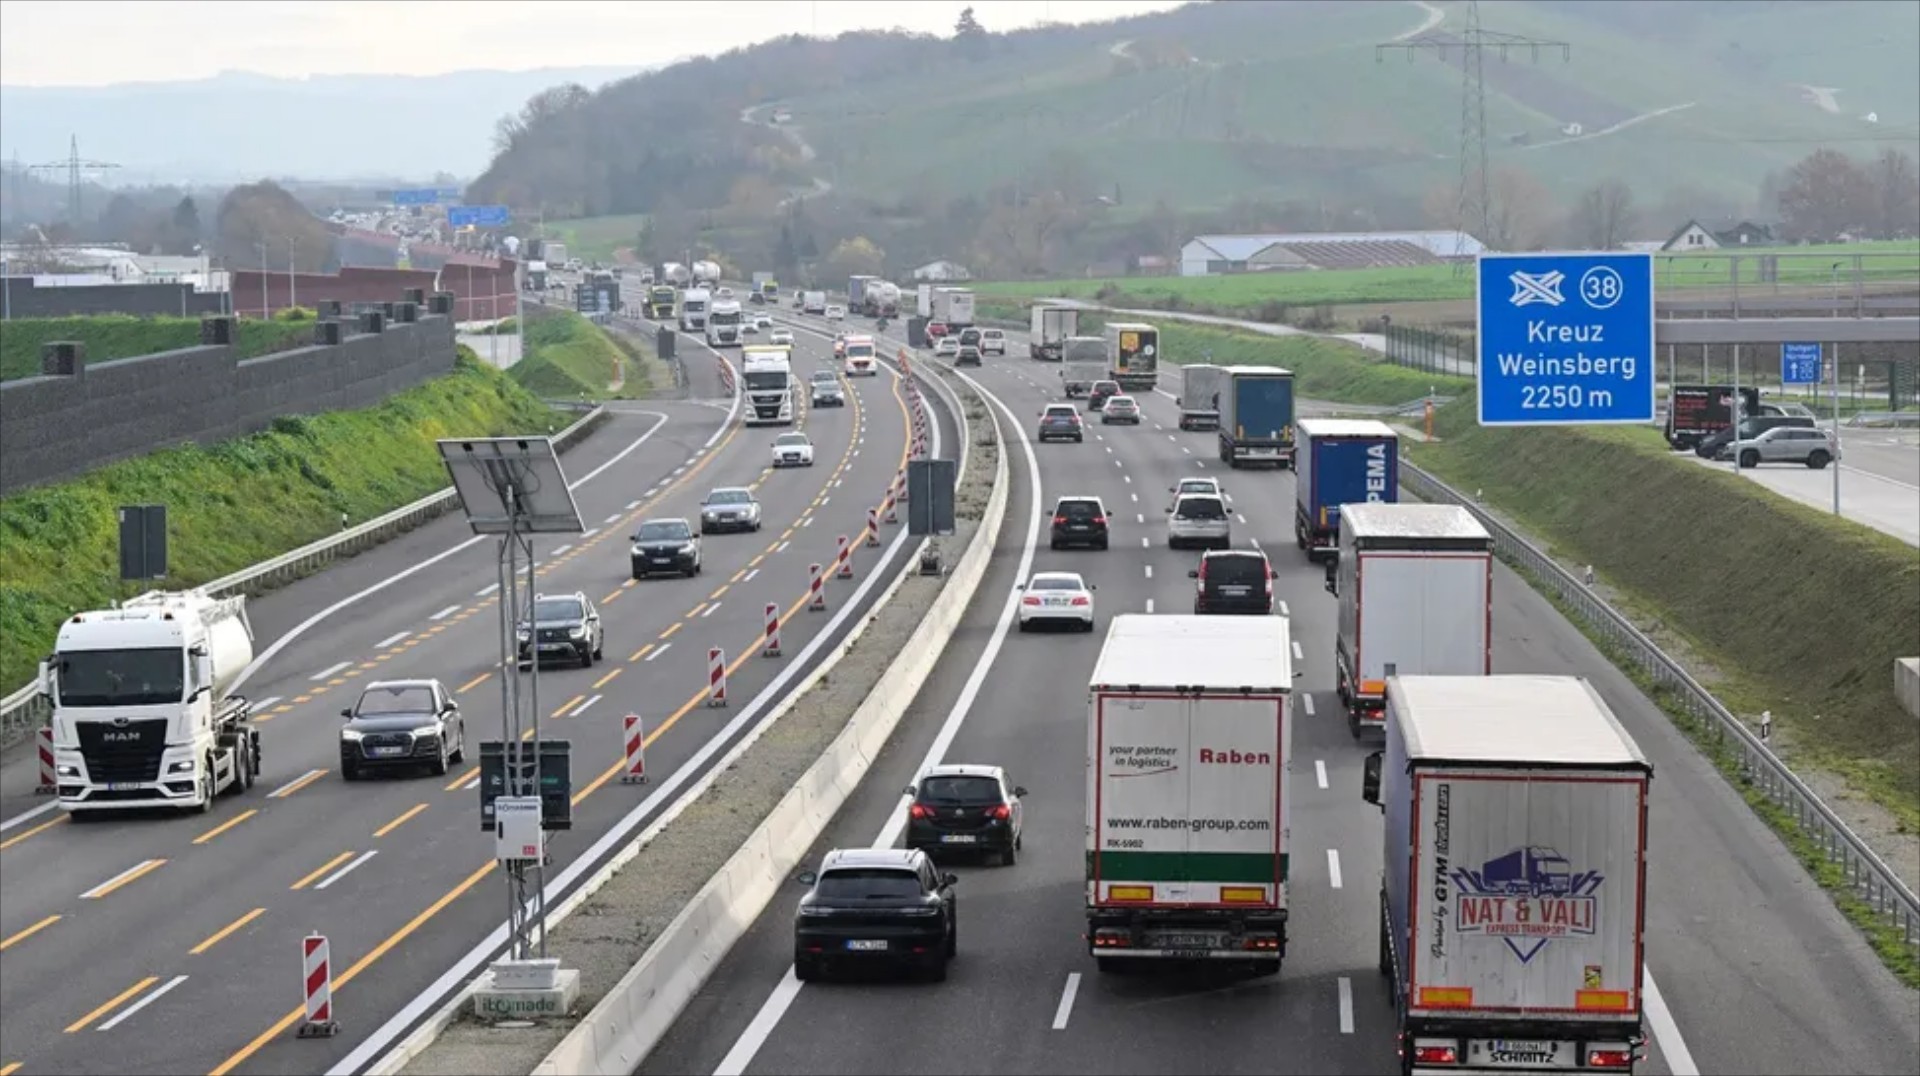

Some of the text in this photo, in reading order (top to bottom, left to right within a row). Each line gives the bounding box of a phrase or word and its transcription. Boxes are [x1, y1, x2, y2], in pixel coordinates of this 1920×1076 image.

[1587, 276, 1616, 299] 38
[1528, 320, 1604, 343] Kreuz
[1497, 352, 1636, 380] Weinsberg
[1521, 385, 1612, 409] 2250 m
[1367, 443, 1385, 503] PEMA
[103, 732, 141, 741] MAN
[1108, 745, 1177, 757] your partner
[1199, 748, 1271, 764] Raben
[1114, 756, 1171, 769] in logistics
[1106, 816, 1270, 832] www.raben-group.com
[1434, 858, 1448, 902] GTM
[1461, 898, 1591, 929] NAT & VALI
[1485, 924, 1566, 935] EXPRESS TRANSPORT
[1490, 1051, 1555, 1063] SCHMITZ
